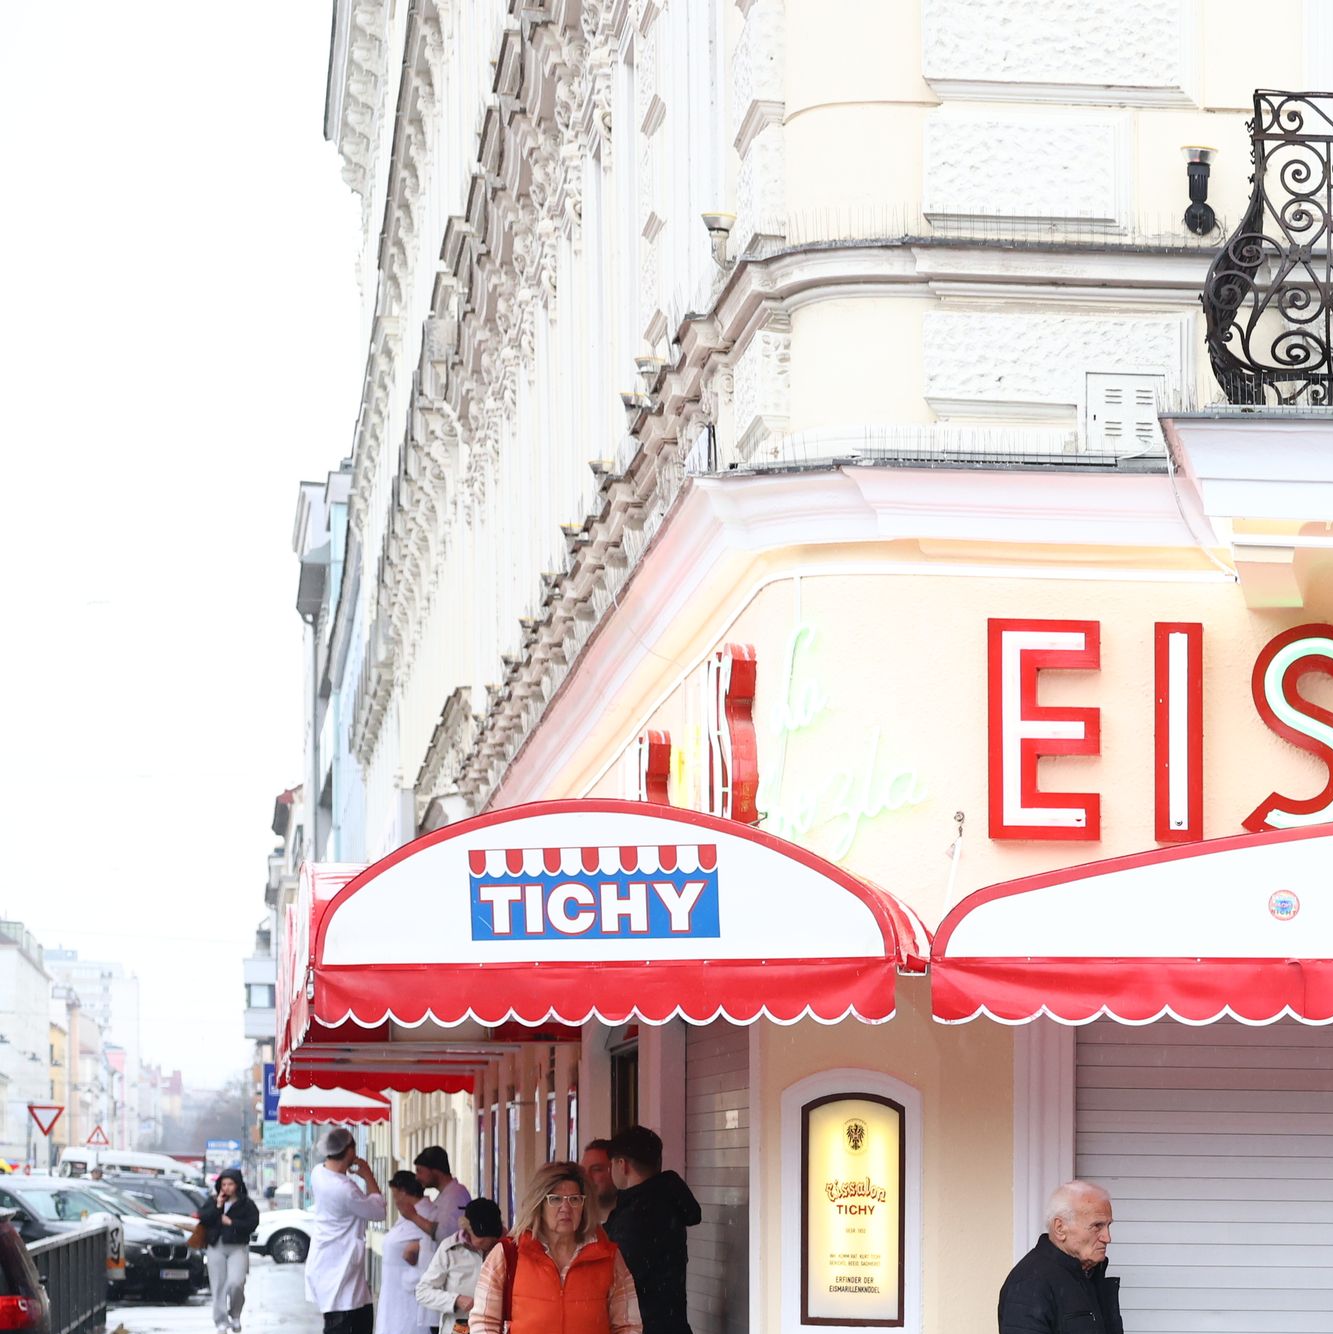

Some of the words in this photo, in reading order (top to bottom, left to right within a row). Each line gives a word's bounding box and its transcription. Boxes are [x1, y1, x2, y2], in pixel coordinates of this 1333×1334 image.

[477, 880, 707, 936] TICHY
[836, 1204, 876, 1215] TICHY
[835, 1276, 862, 1284] ERFINDER
[863, 1276, 874, 1284] DER
